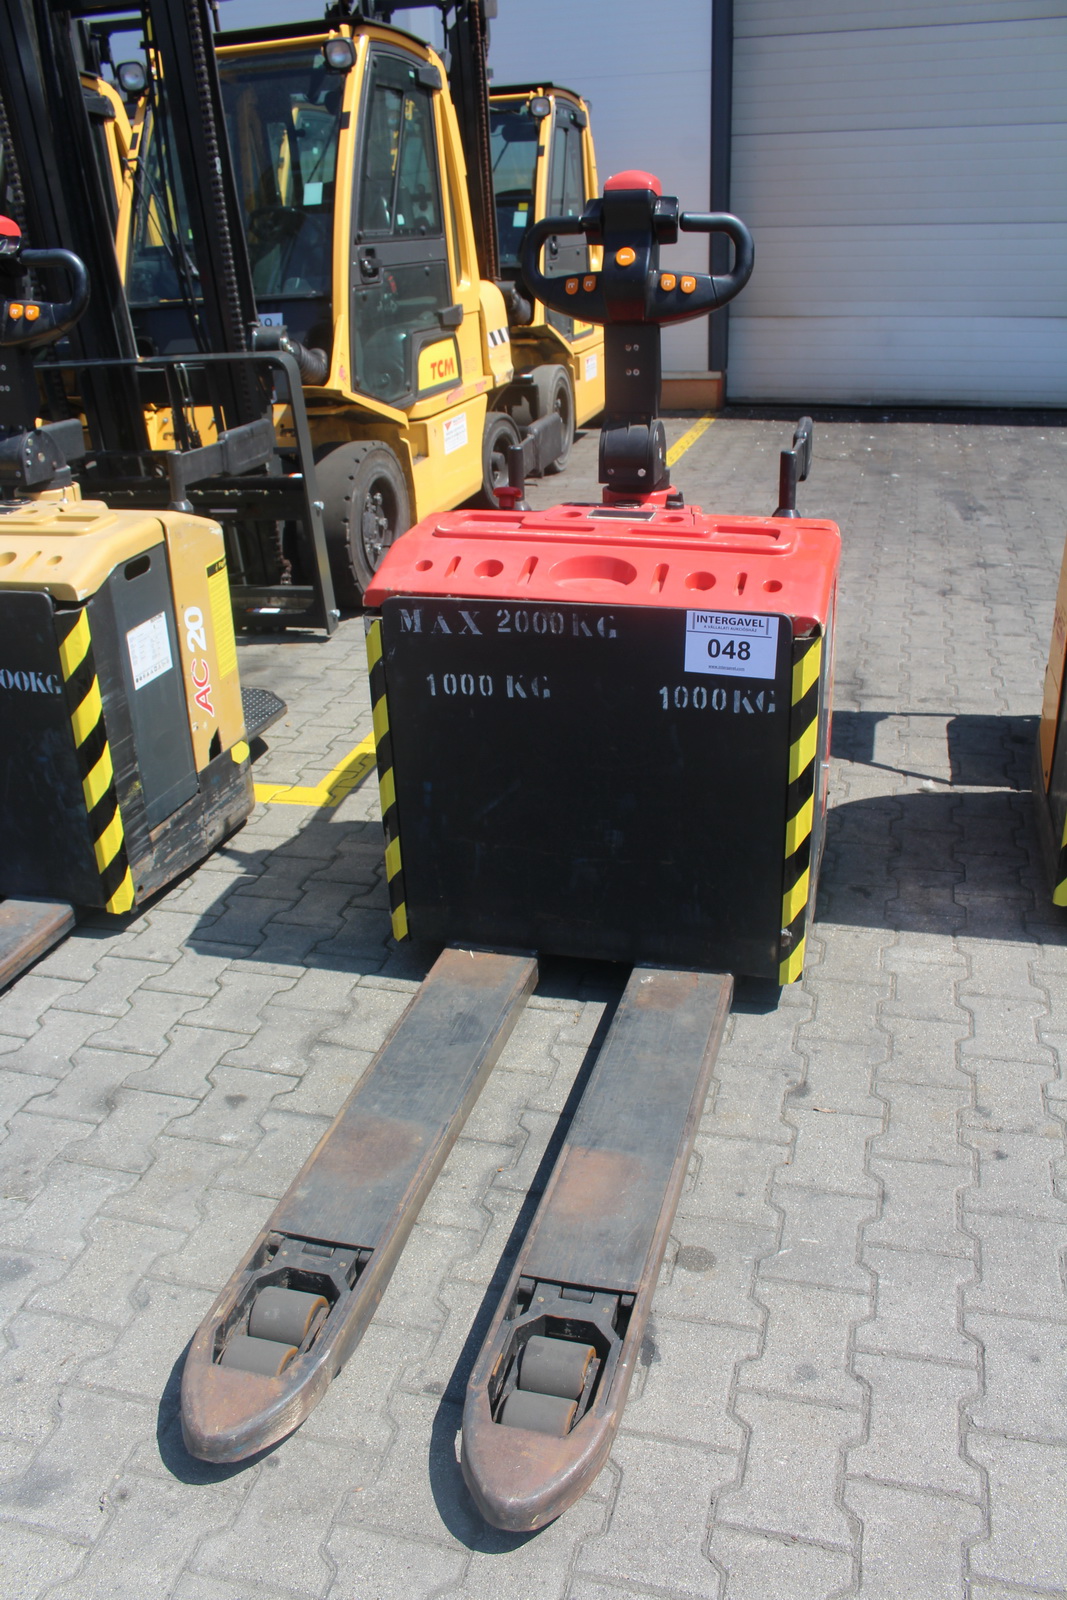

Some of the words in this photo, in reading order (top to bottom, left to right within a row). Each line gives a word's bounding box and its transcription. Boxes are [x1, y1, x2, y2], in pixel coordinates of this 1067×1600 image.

[430, 357, 455, 380] TCM
[183, 606, 207, 652] 20
[398, 608, 483, 636] MAX
[696, 614, 765, 628] INTERGAVEL
[707, 638, 751, 661] 048
[191, 658, 215, 717] AC
